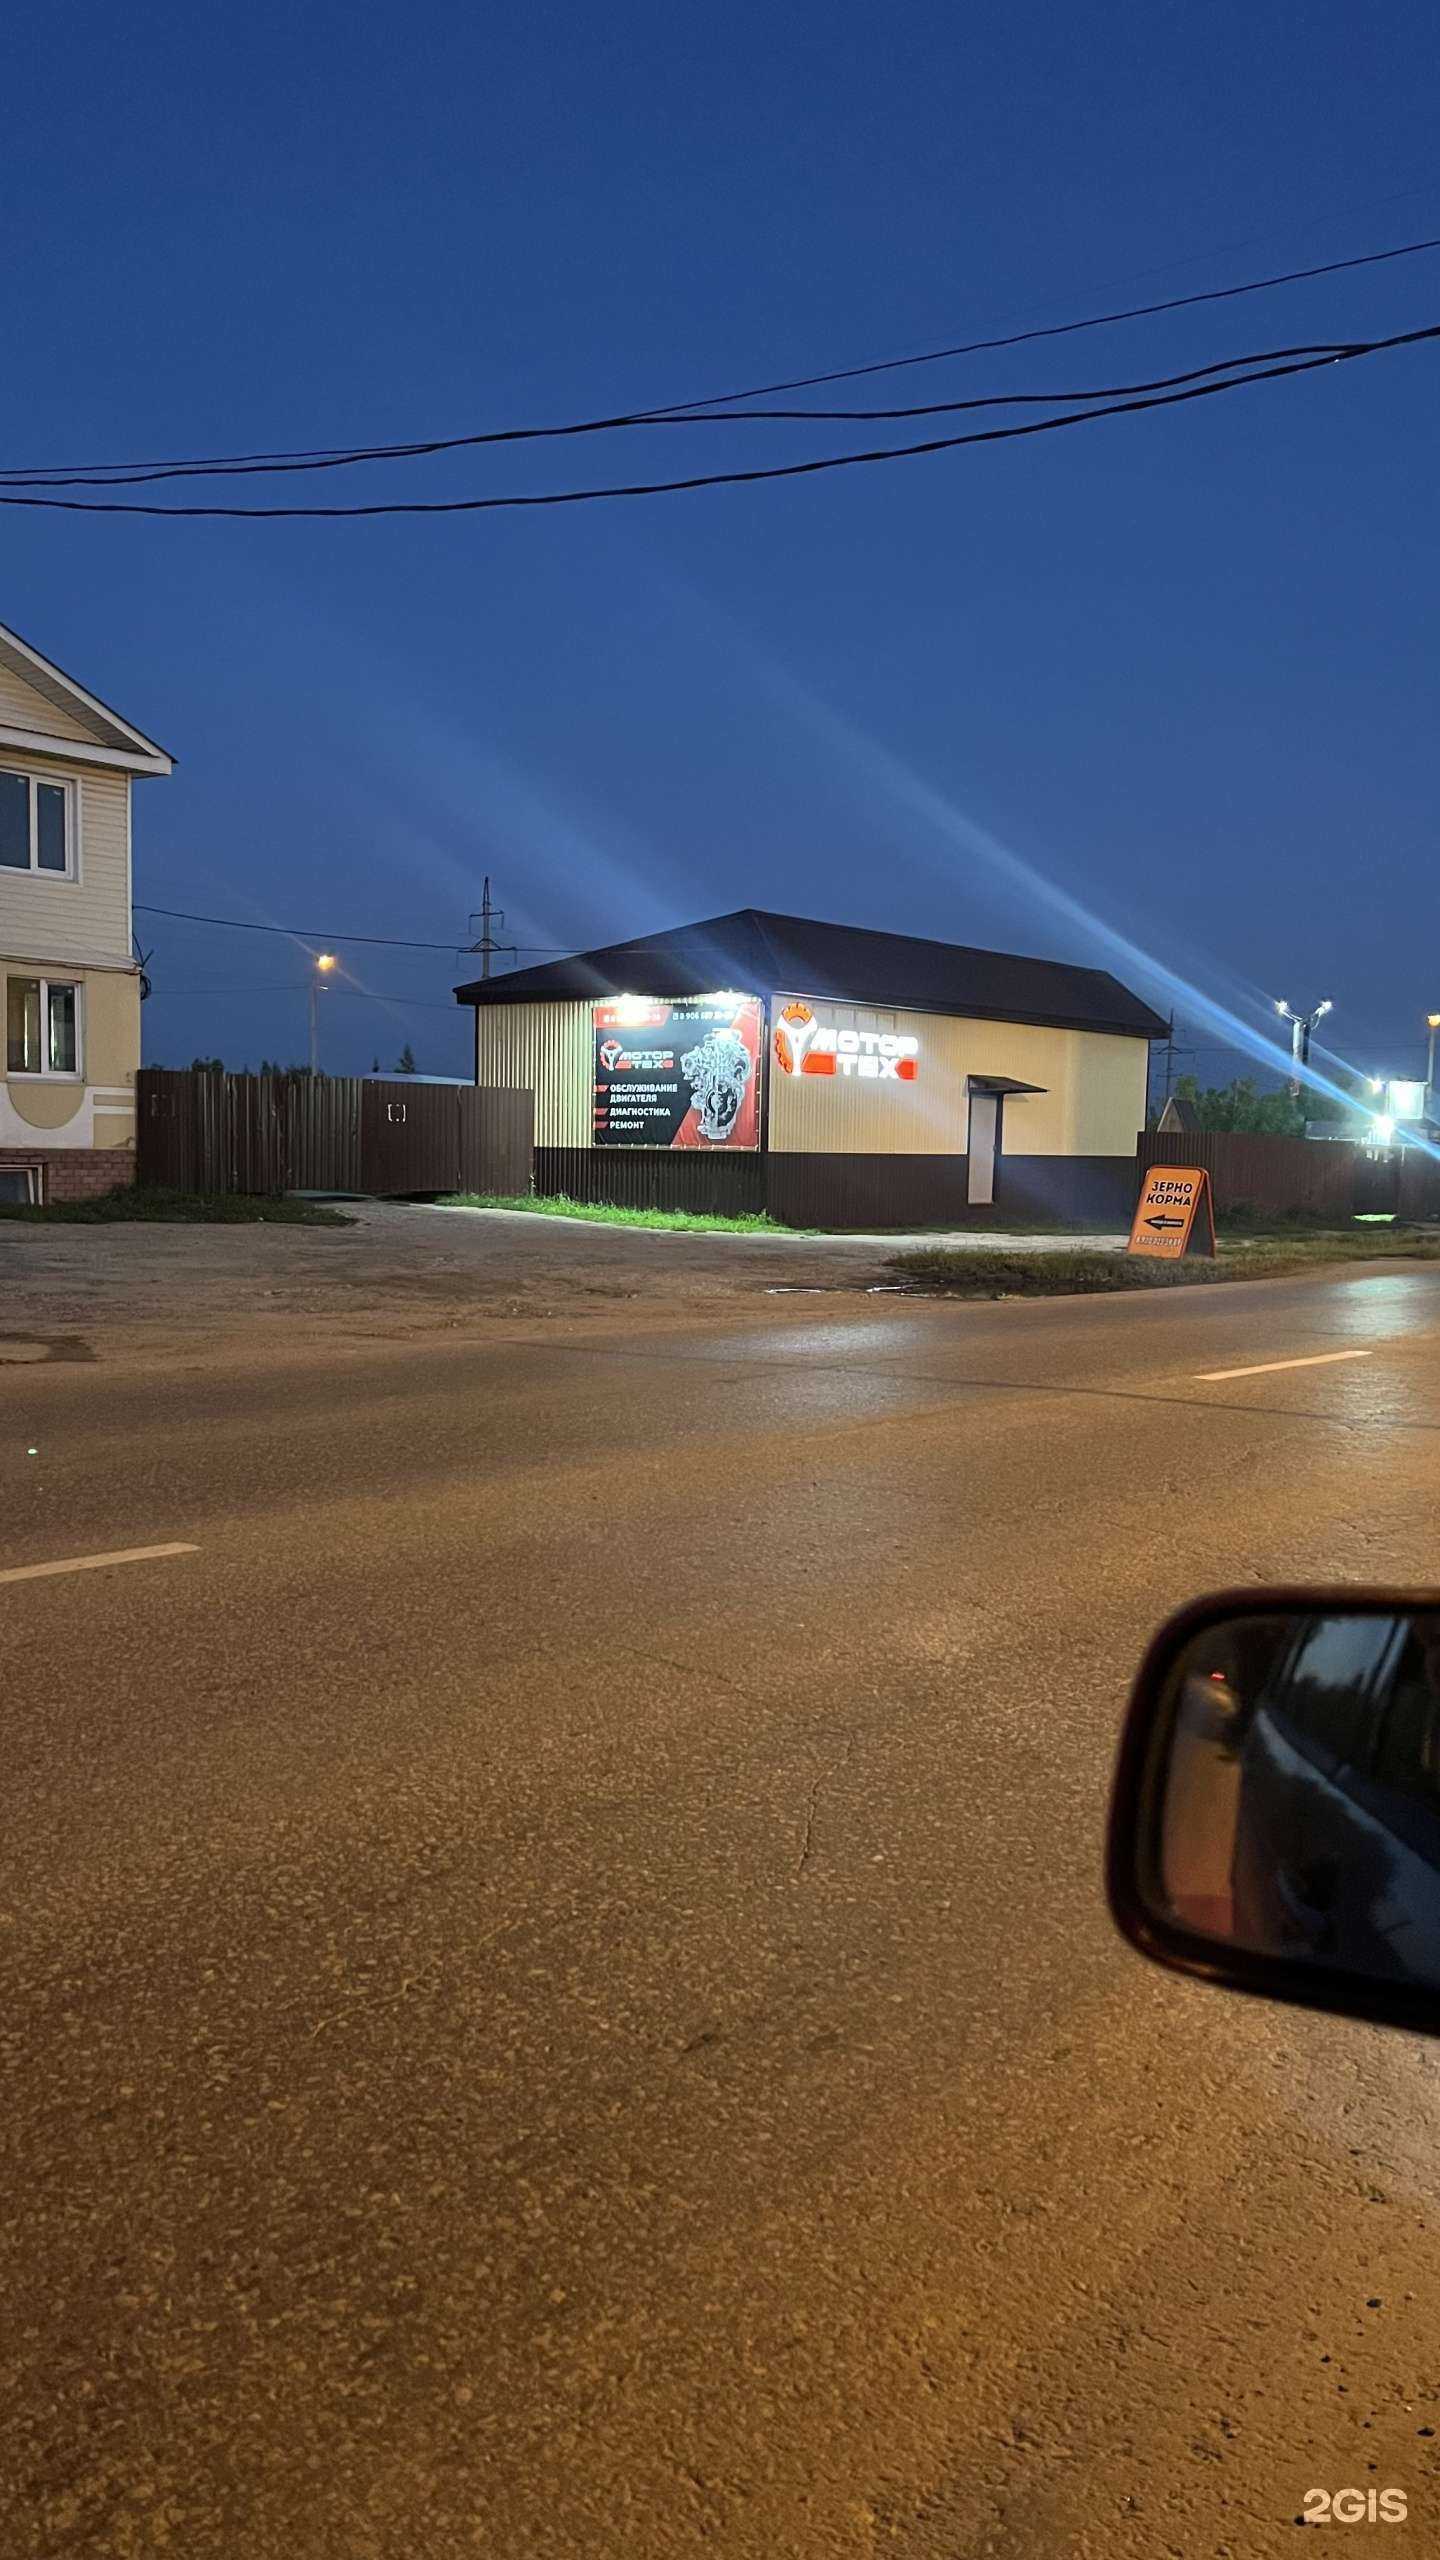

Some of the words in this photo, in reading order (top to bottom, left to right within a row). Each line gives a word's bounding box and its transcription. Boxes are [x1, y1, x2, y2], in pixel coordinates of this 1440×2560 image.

[810, 1028, 919, 1057] МОТОР
[619, 1050, 674, 1061] МОТОР
[631, 1060, 664, 1069] ТЕХ
[836, 1053, 901, 1079] ТЕХ
[609, 1083, 678, 1093] ОБСЛУЖИВАНИЕ
[609, 1094, 657, 1103] ДВИГАТЕЛЯ
[609, 1107, 671, 1116] ДИАГНОСТИКА
[609, 1121, 645, 1129] РЕМОНТ
[1151, 1181, 1193, 1193] ЗЕРНО
[1146, 1193, 1191, 1206] КОРМА
